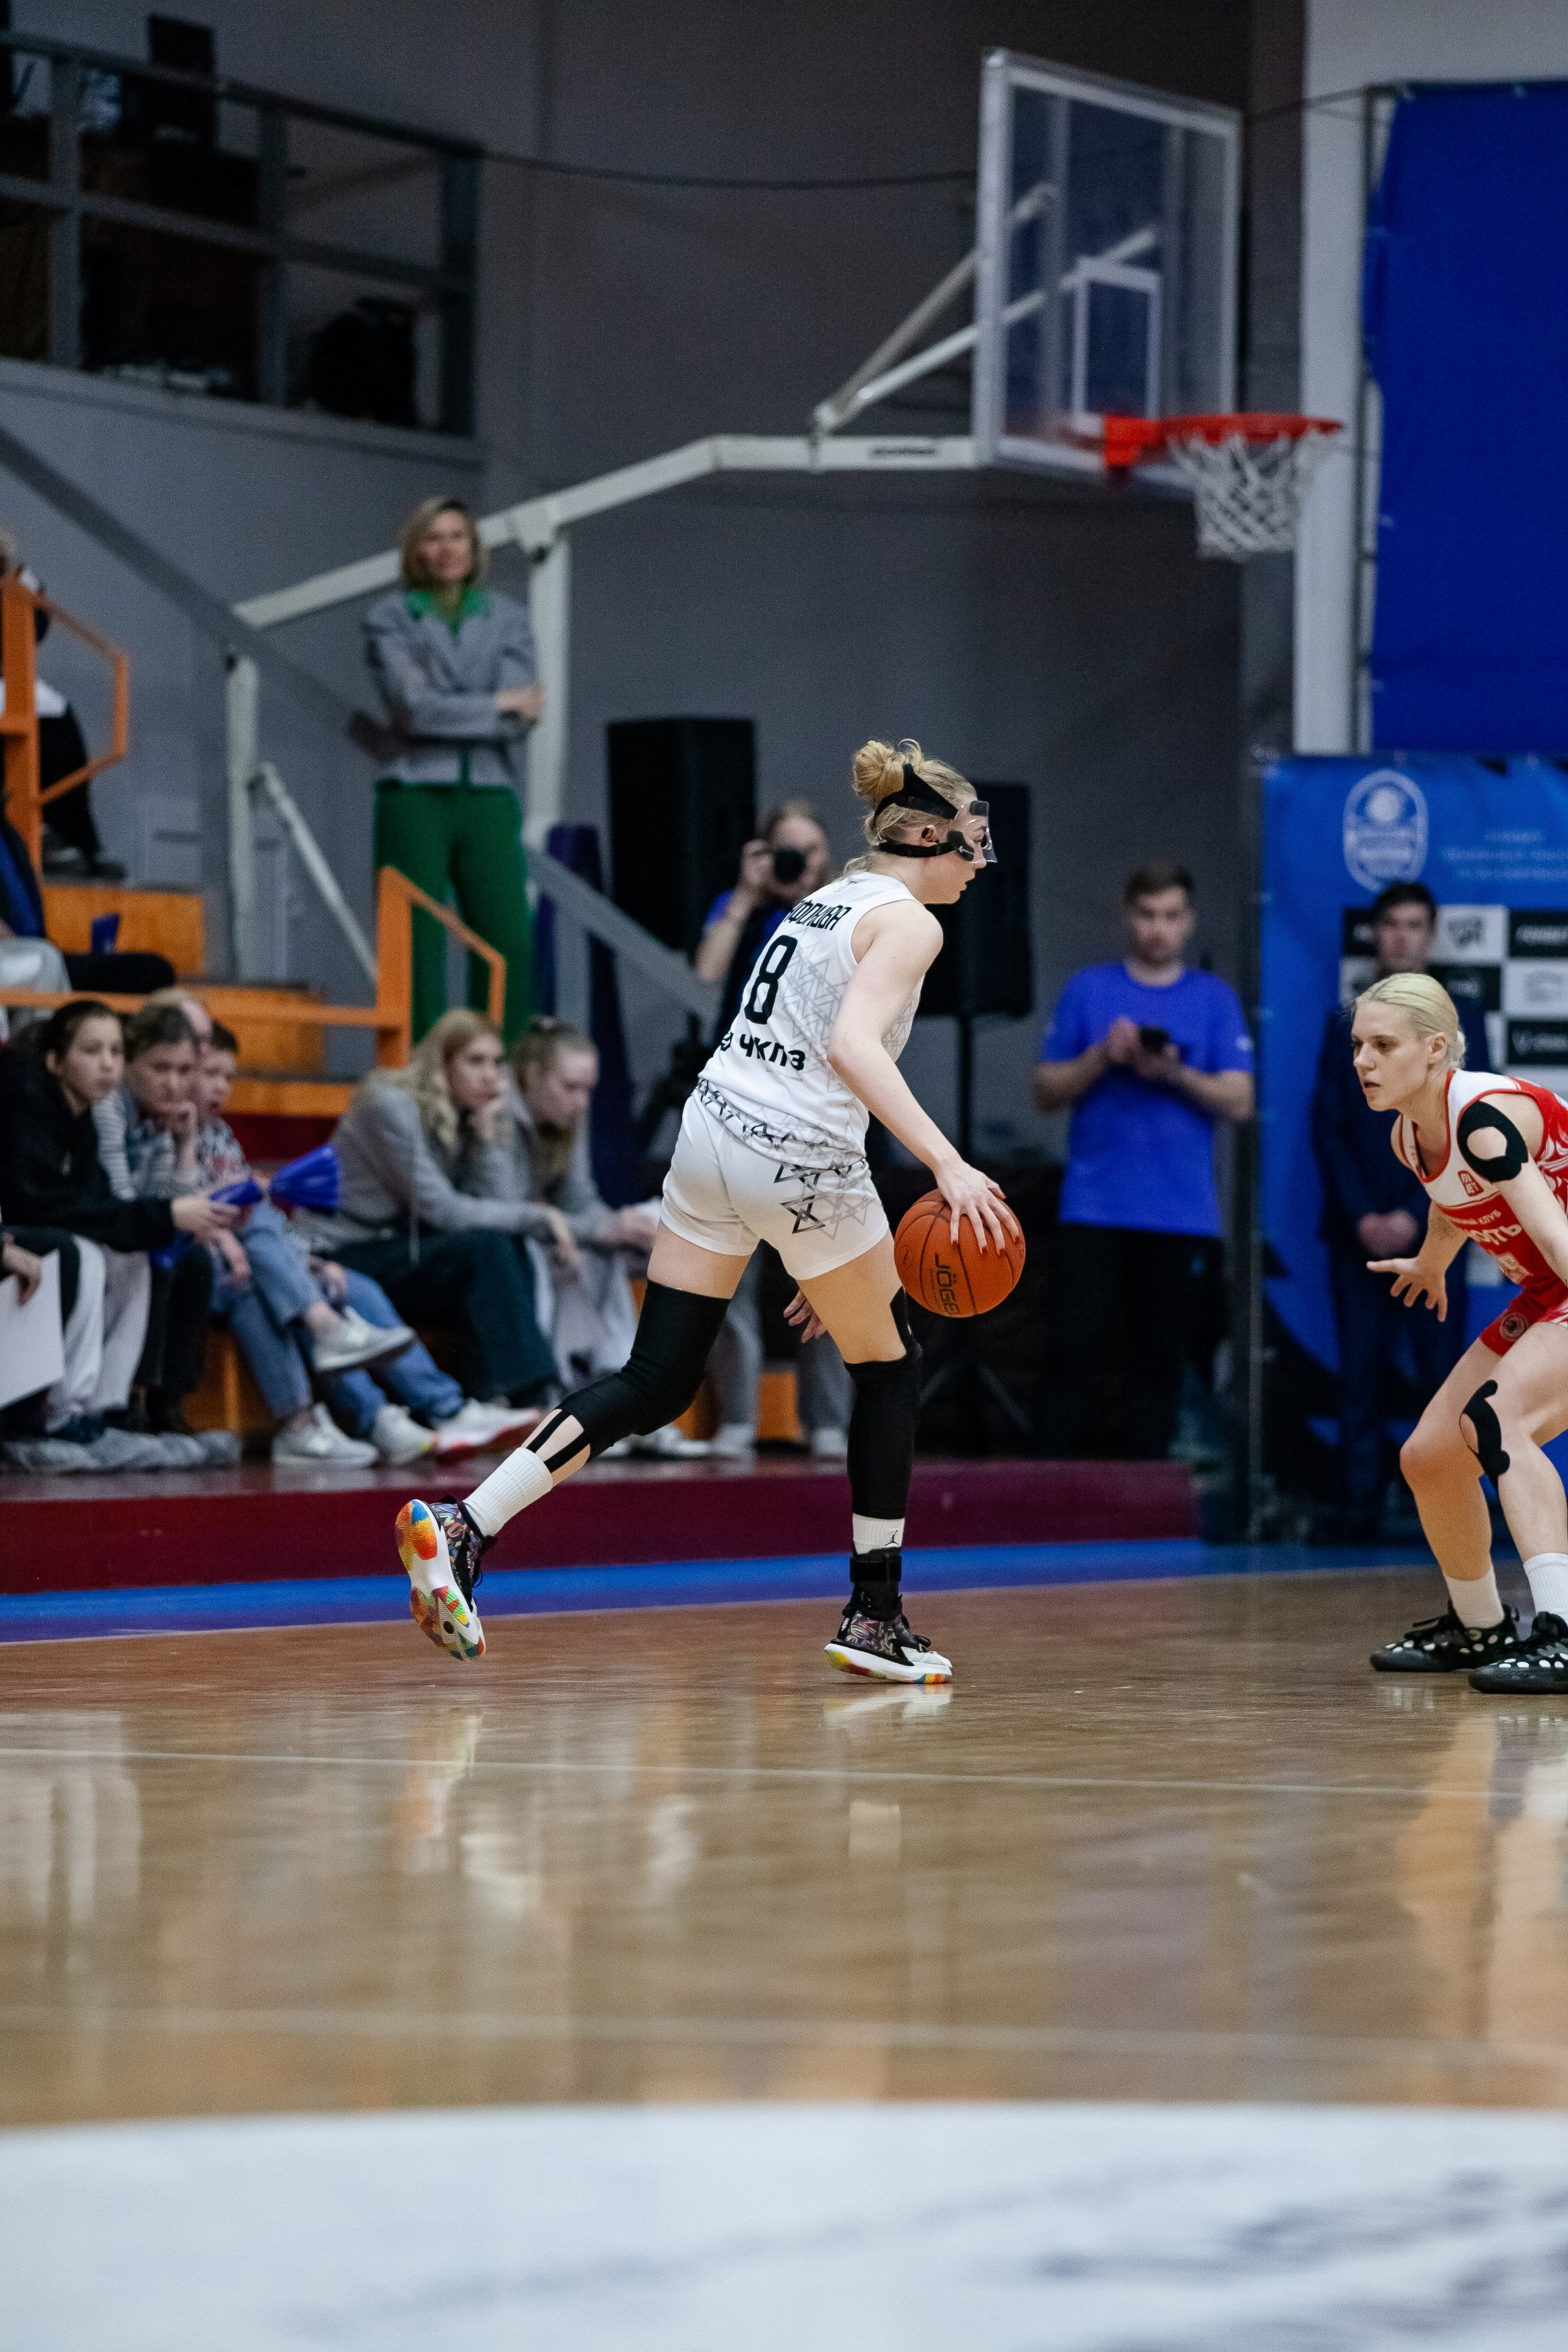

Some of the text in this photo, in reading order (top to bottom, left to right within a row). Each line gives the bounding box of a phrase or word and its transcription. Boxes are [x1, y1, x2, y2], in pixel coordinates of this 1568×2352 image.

[744, 935, 797, 1025] 8
[740, 1034, 806, 1071] ЧКПЗ
[934, 1252, 961, 1314] JÖGE
